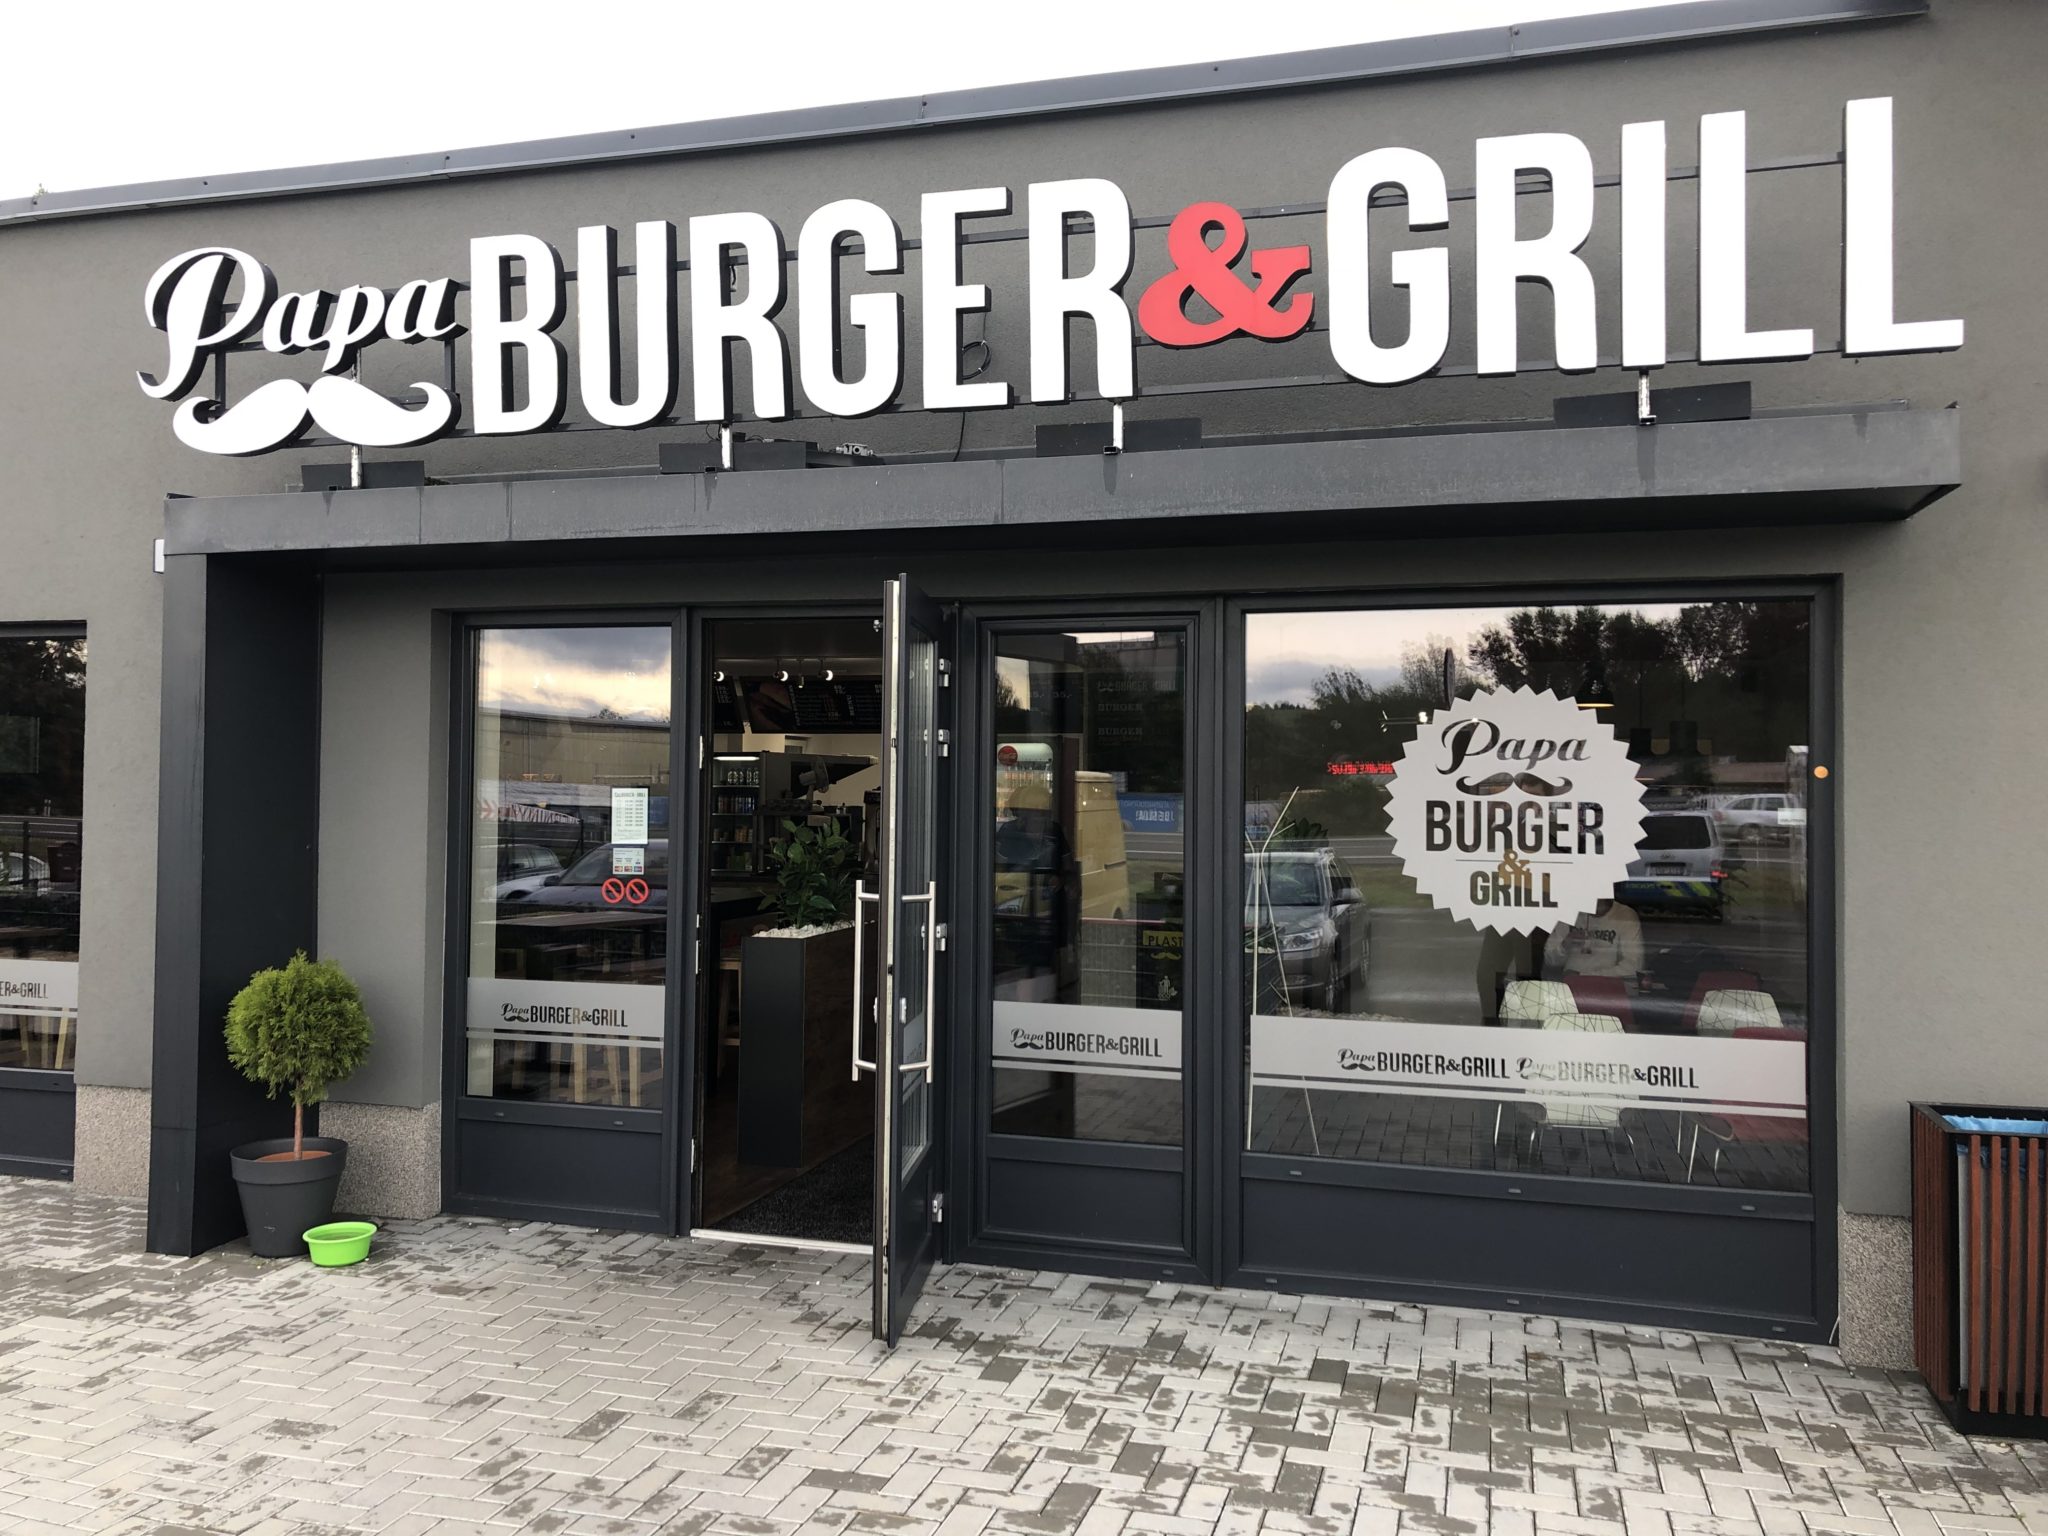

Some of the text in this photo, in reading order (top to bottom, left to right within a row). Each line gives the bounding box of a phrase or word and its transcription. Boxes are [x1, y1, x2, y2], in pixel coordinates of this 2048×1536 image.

[136, 246, 461, 401] Papa
[1435, 719, 1591, 775] Papa
[1425, 800, 1604, 855] BURGER
[1498, 849, 1530, 878] &
[1469, 871, 1559, 908] GRILL
[501, 1002, 530, 1017] Papa
[1010, 1027, 1044, 1043] Papa
[1336, 1047, 1376, 1065] Papa
